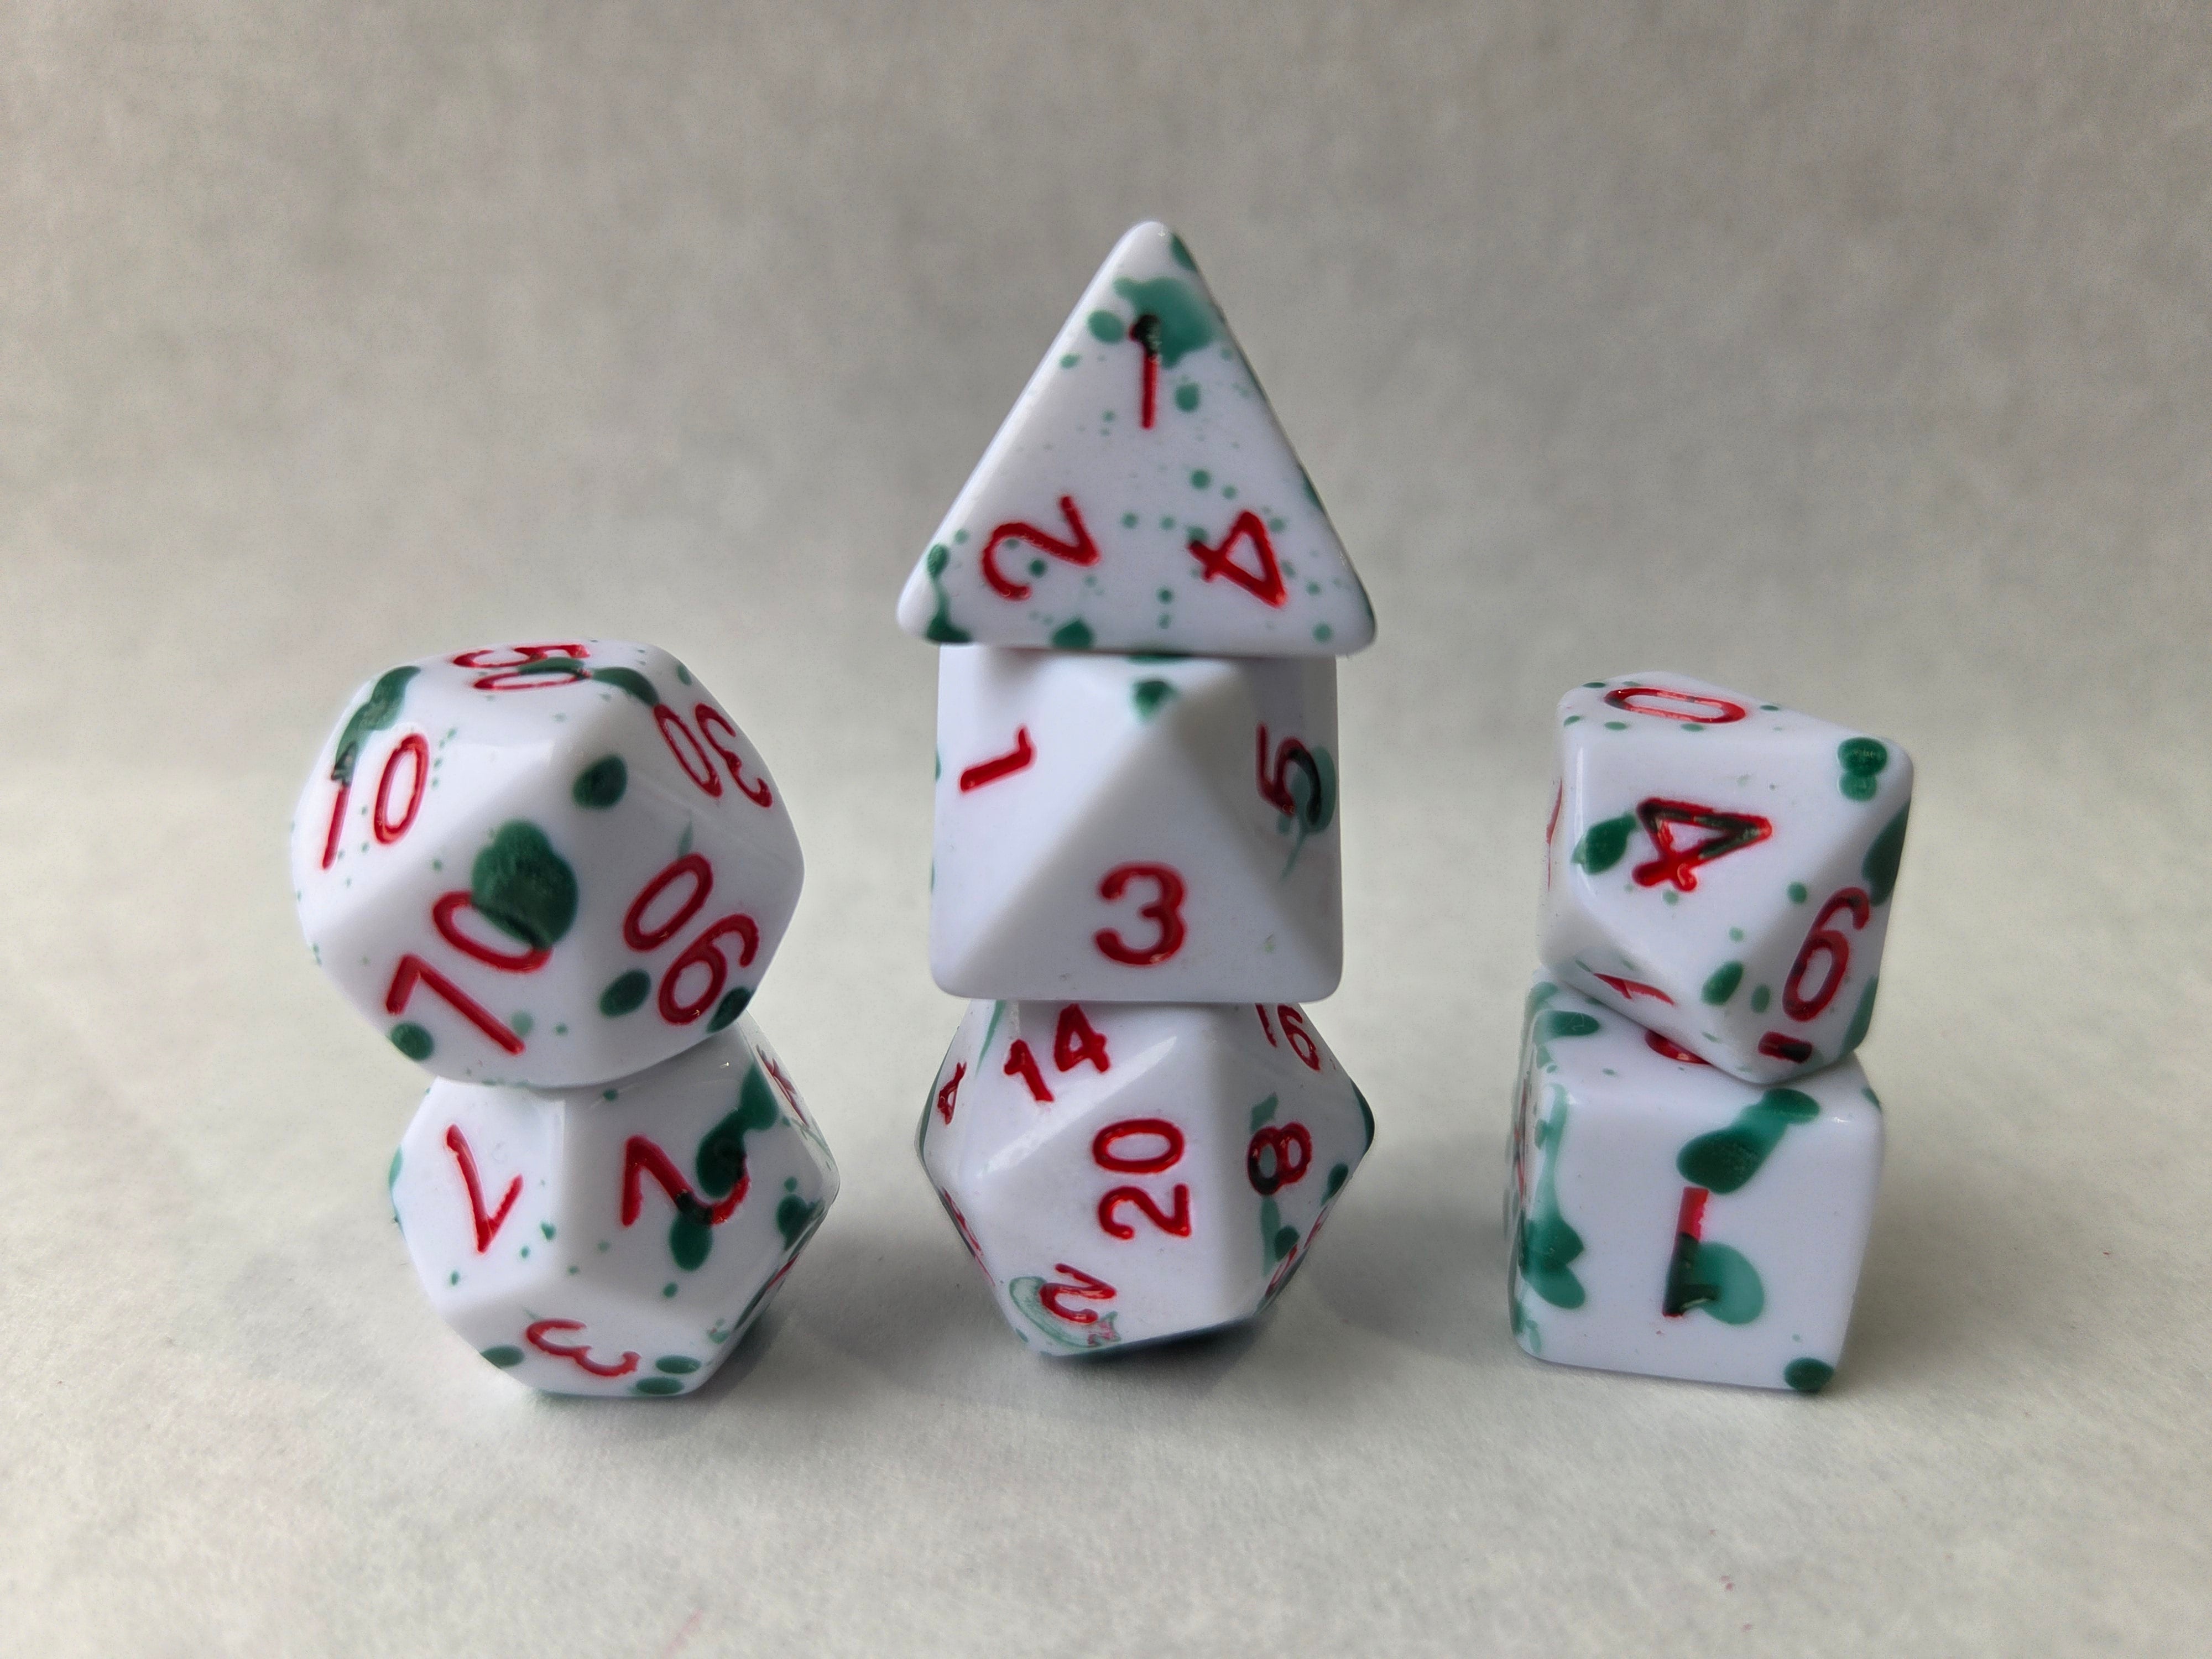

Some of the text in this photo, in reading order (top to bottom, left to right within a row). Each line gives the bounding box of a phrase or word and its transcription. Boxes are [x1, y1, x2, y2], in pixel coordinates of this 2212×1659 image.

[1129, 315, 1159, 430] 1
[980, 495, 1102, 601] 2
[1188, 510, 1288, 608] 4
[451, 643, 591, 691] 50
[1605, 687, 1747, 724] 0
[320, 733, 429, 870] 10
[653, 702, 773, 808] 30
[958, 723, 1036, 795] 1
[1256, 722, 1321, 824] 5
[1633, 797, 1774, 894] 4
[1094, 862, 1188, 967] 3
[383, 890, 553, 1056] 70
[1003, 1004, 1112, 1103] 14
[1254, 1003, 1321, 1072] 16
[621, 1135, 751, 1227] 2
[1092, 1118, 1191, 1241] 20
[1247, 1121, 1313, 1196] 8
[1039, 1264, 1117, 1325] 2
[1662, 1187, 1721, 1317] 1
[526, 1319, 640, 1378] 3
